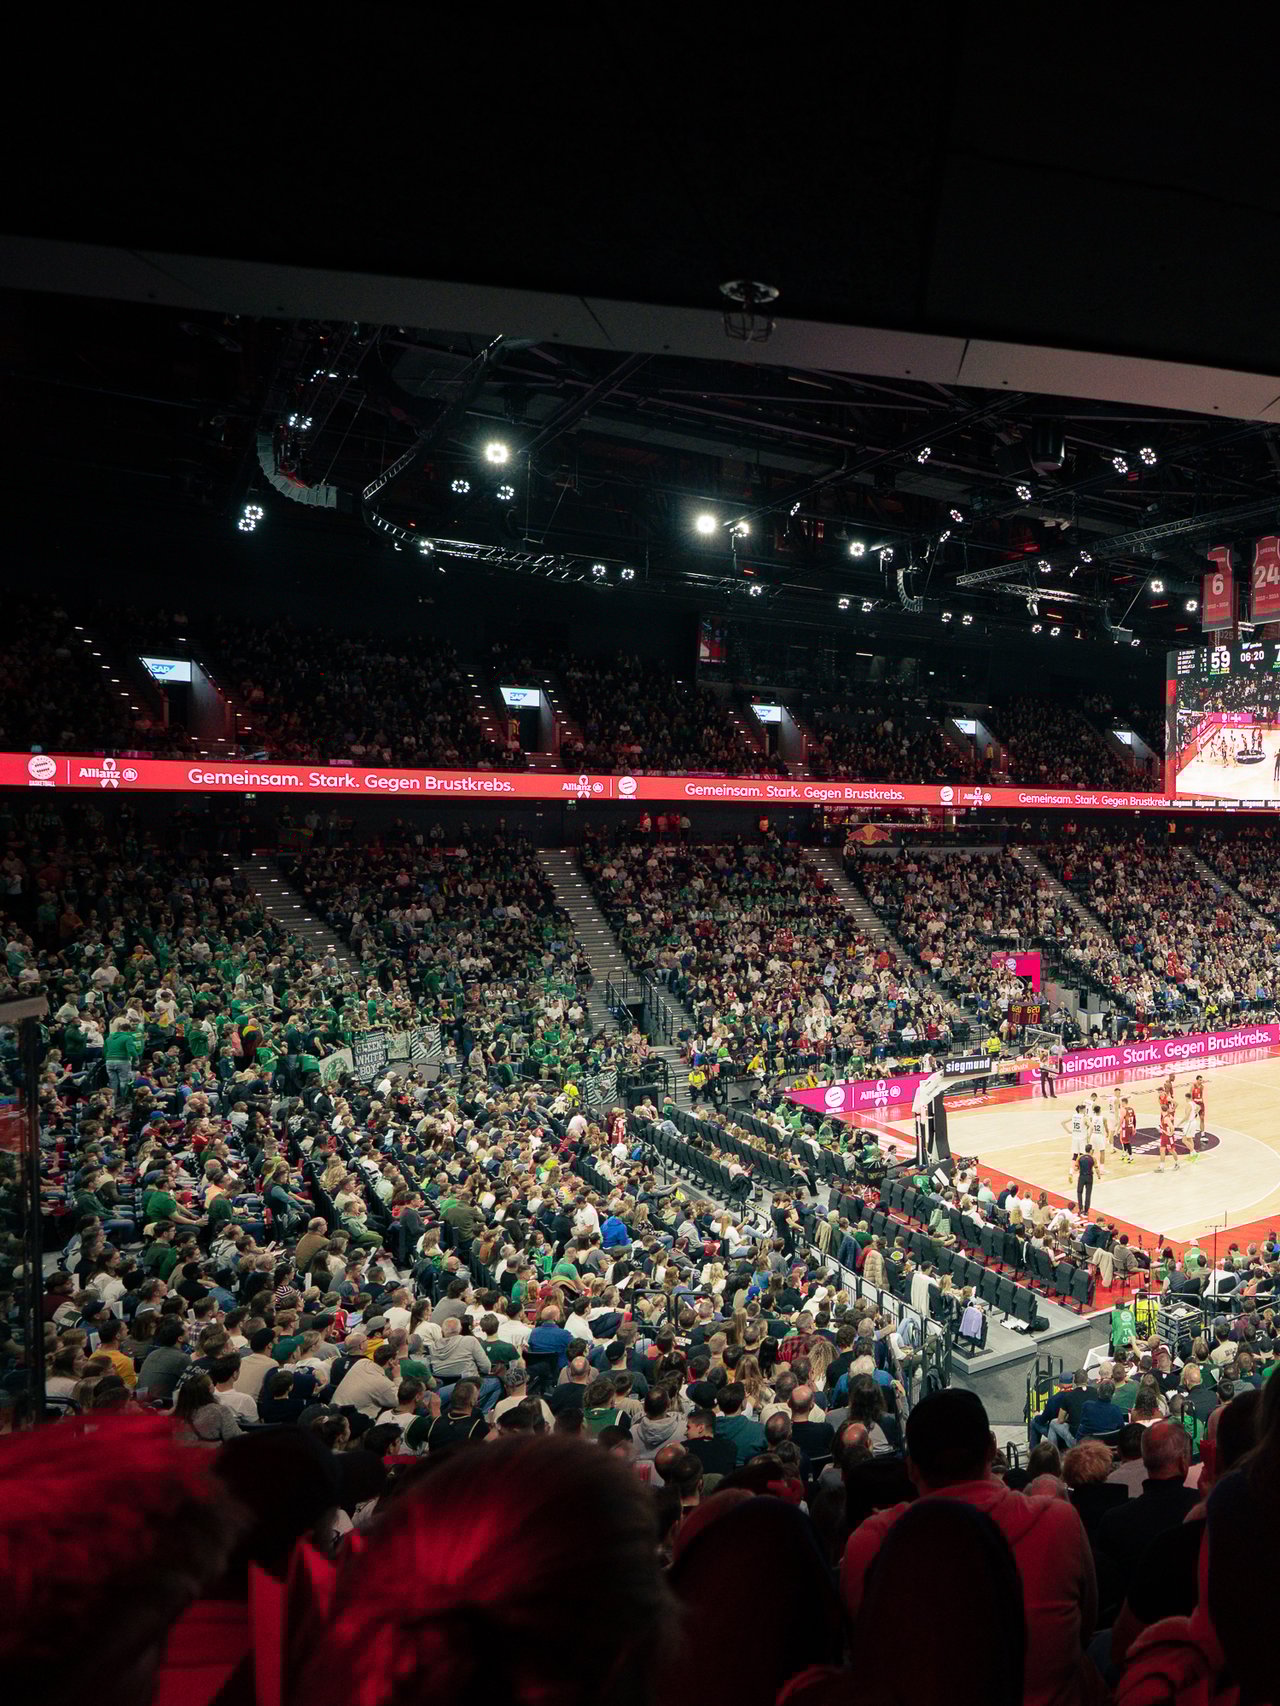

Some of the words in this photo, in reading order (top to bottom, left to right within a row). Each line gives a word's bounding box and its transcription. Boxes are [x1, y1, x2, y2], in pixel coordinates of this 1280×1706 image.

[1254, 563, 1280, 589] 24
[1212, 573, 1224, 596] 6
[1211, 651, 1230, 669] 59
[1240, 650, 1265, 662] 06:20
[79, 767, 120, 779] Allianz
[188, 768, 303, 787] Gemeinsam.
[309, 772, 360, 788] Stark.
[364, 774, 420, 792] Gegen
[425, 775, 515, 793] Brustkrebs.
[562, 782, 591, 792] Allianz
[684, 783, 763, 798] Gemeinsam.
[766, 785, 801, 798] Stark.
[803, 786, 841, 801] Gegen
[844, 787, 905, 800] Brustkrebs.
[1018, 793, 1073, 804] Gemeinsam.
[1075, 794, 1100, 805] Stark.
[1101, 795, 1128, 807] Gegen
[1130, 795, 1167, 807] Brustkreb
[1027, 1013, 1039, 1023] 10
[355, 1051, 384, 1065] WHITE
[1032, 1053, 1120, 1077] Gmeinsam.
[1123, 1045, 1161, 1065] Stark.
[1164, 1040, 1205, 1059] Gegen
[1208, 1030, 1272, 1051] Brustkrebs.
[945, 1057, 991, 1074] siegmund
[860, 1089, 889, 1101] Allianz
